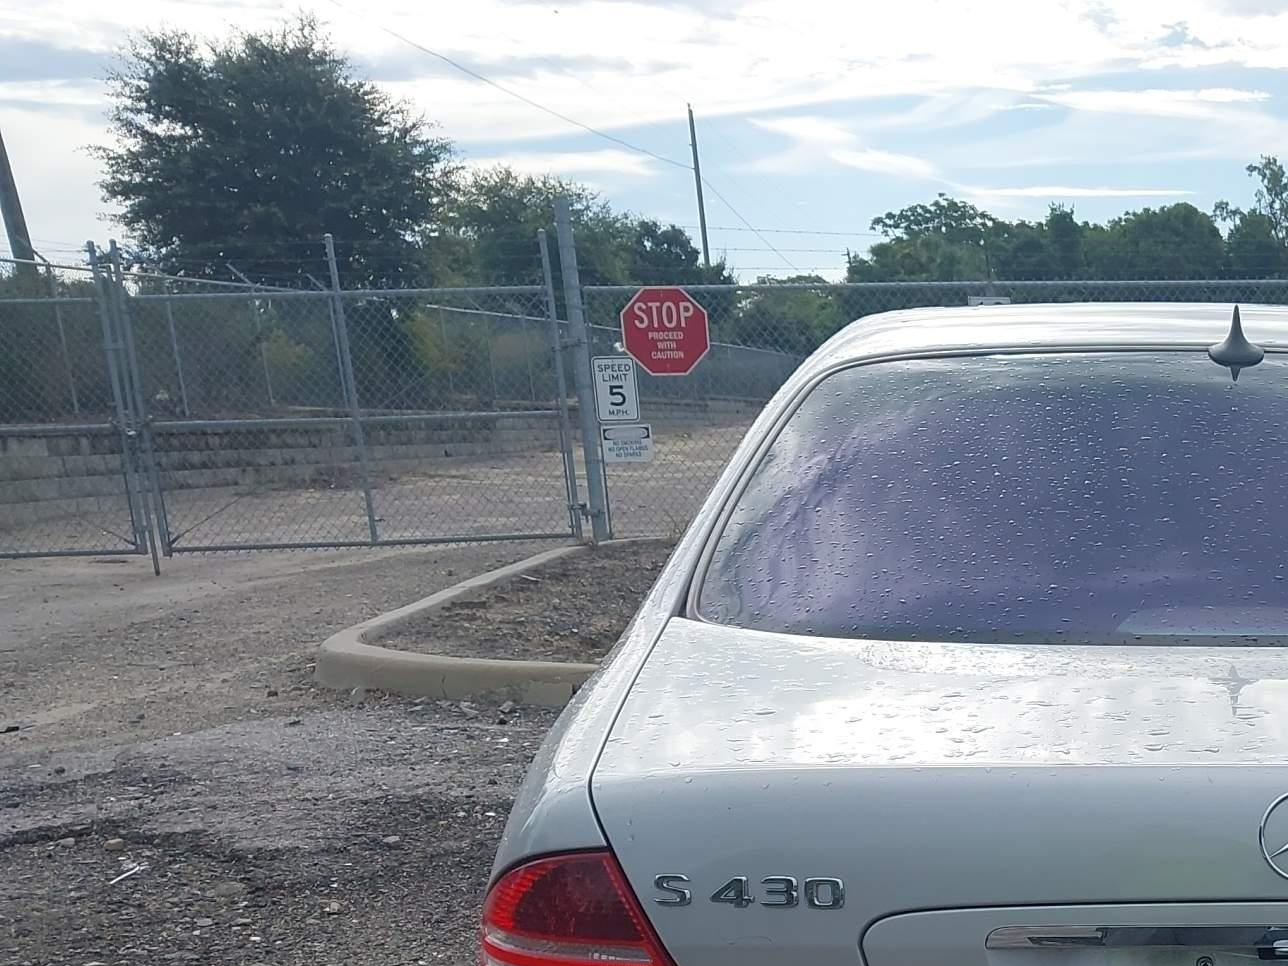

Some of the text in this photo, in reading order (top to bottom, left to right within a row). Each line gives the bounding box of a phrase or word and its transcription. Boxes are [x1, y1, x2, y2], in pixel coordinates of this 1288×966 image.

[633, 301, 694, 329] STOP
[648, 331, 684, 340] PROCEED
[657, 341, 677, 350] WITH
[651, 350, 684, 359] CAUTION
[597, 363, 631, 373] SPEED
[602, 373, 628, 383] LIMIT
[608, 385, 626, 407] 5
[654, 873, 845, 910] S 430
